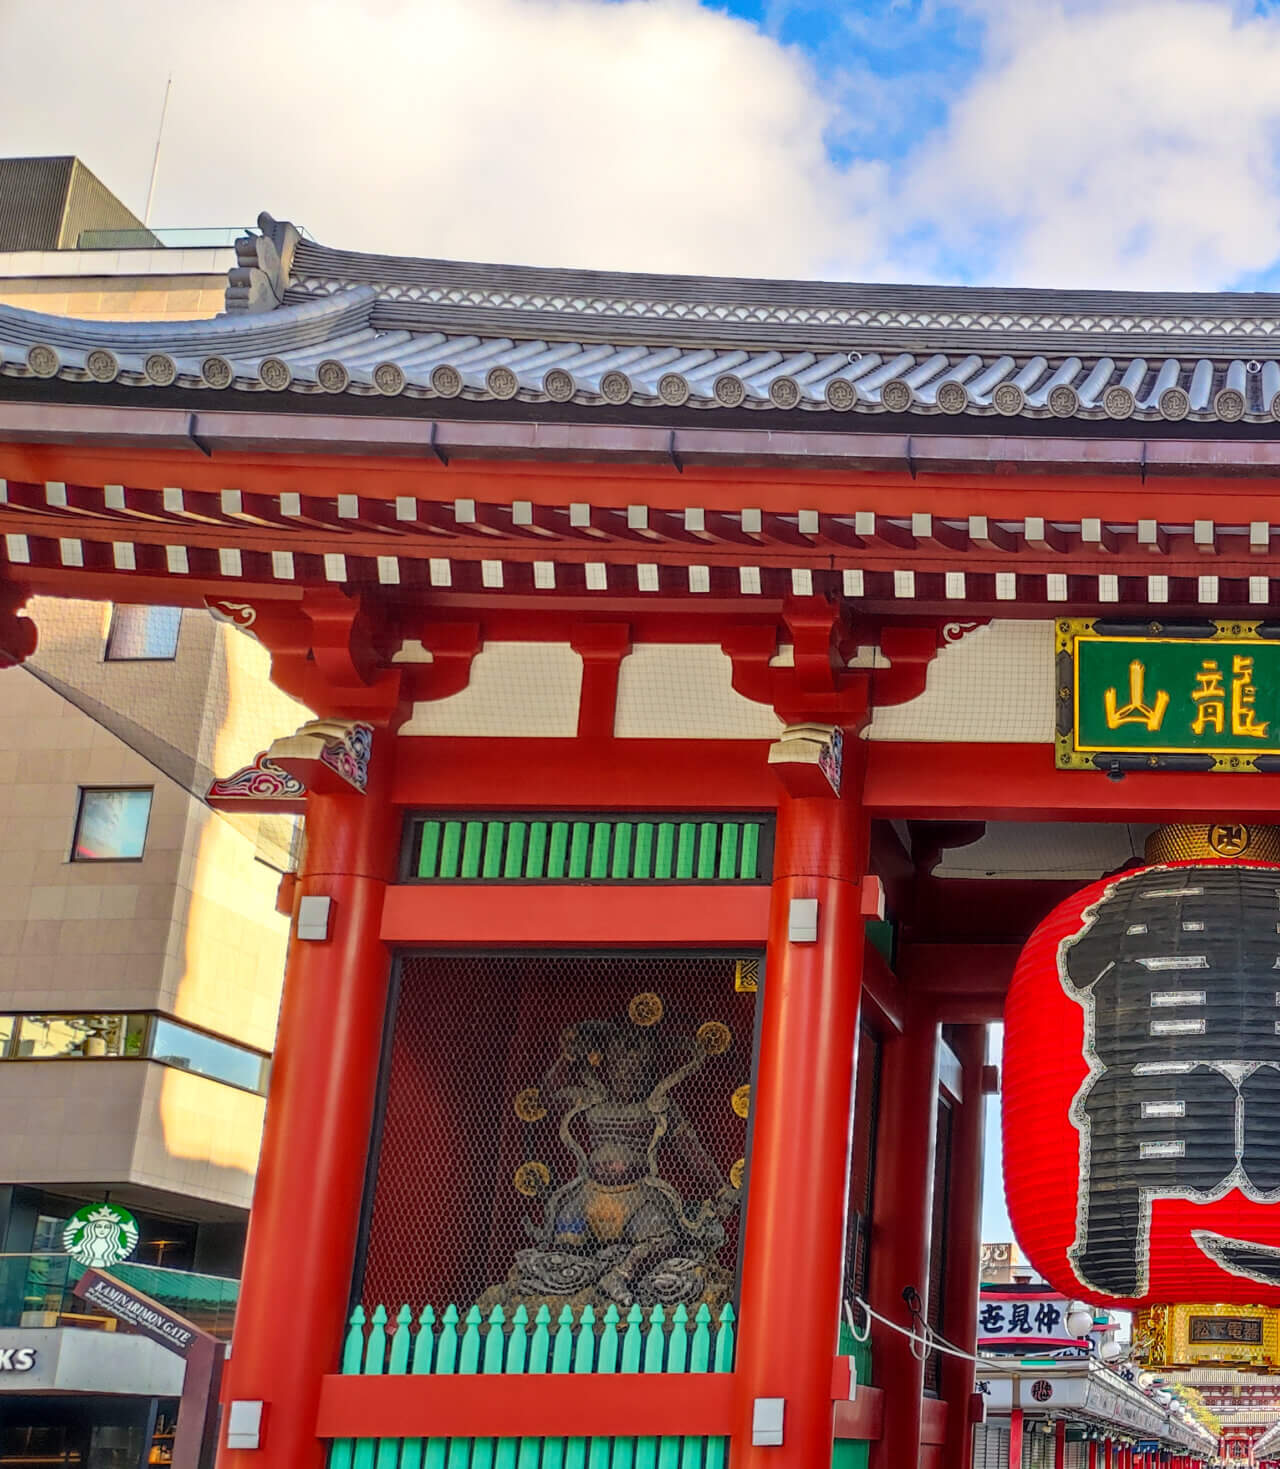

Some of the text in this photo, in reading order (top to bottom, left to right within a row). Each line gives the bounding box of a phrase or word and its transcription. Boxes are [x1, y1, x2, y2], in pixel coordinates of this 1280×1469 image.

[94, 1281, 164, 1327] KAMINARIMON
[163, 1322, 192, 1343] GATE
[1194, 1321, 1258, 1340] 松下電器
